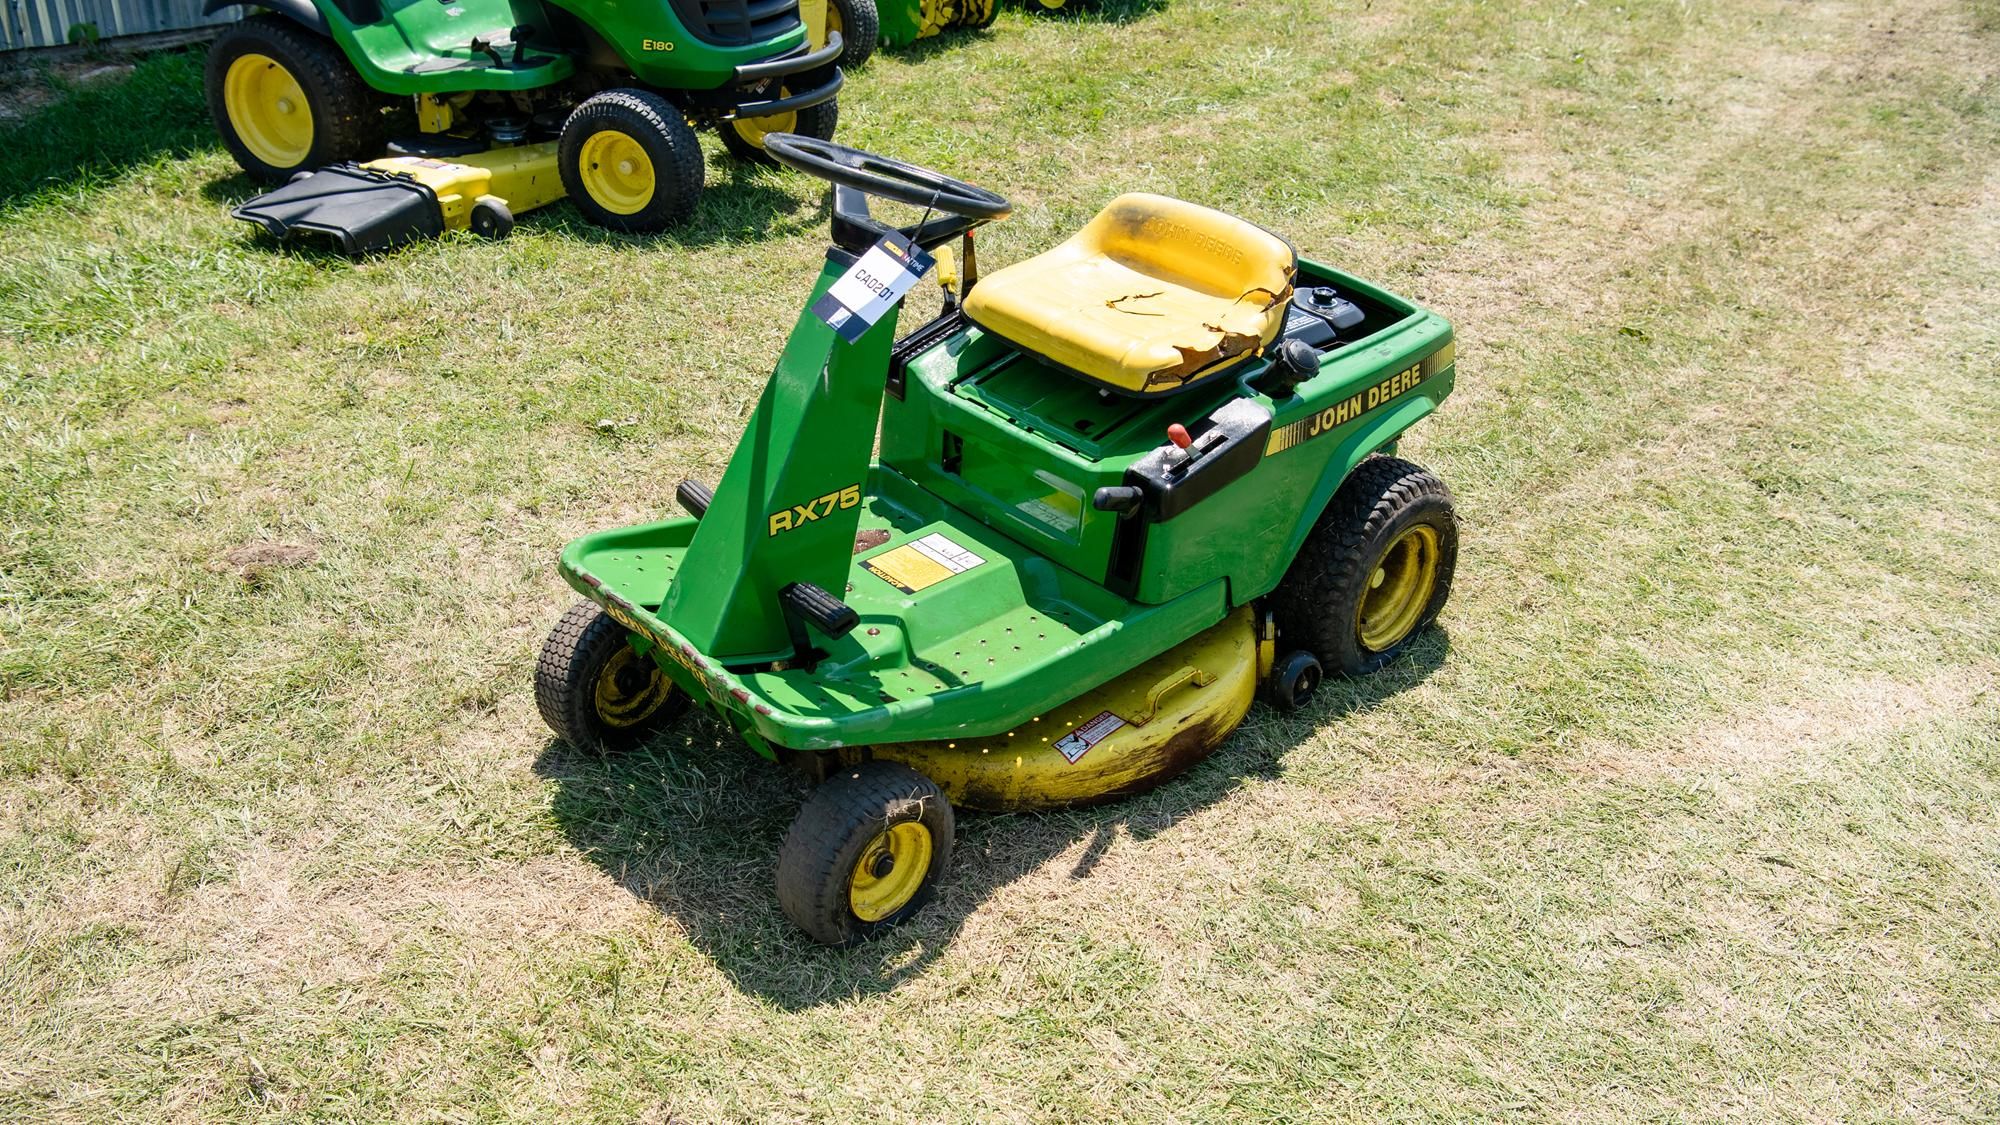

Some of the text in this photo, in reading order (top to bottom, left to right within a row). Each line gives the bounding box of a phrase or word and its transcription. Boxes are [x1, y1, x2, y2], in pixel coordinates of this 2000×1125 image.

[643, 39, 674, 51] E180
[1142, 215, 1244, 265] JOHN DEERE
[855, 269, 894, 301] CA0201
[1310, 363, 1421, 436] JOHN DEERE
[768, 483, 862, 537] RX75
[868, 566, 899, 588] CAUTION
[607, 604, 655, 640] JOHN
[1080, 711, 1112, 733] DANGER
